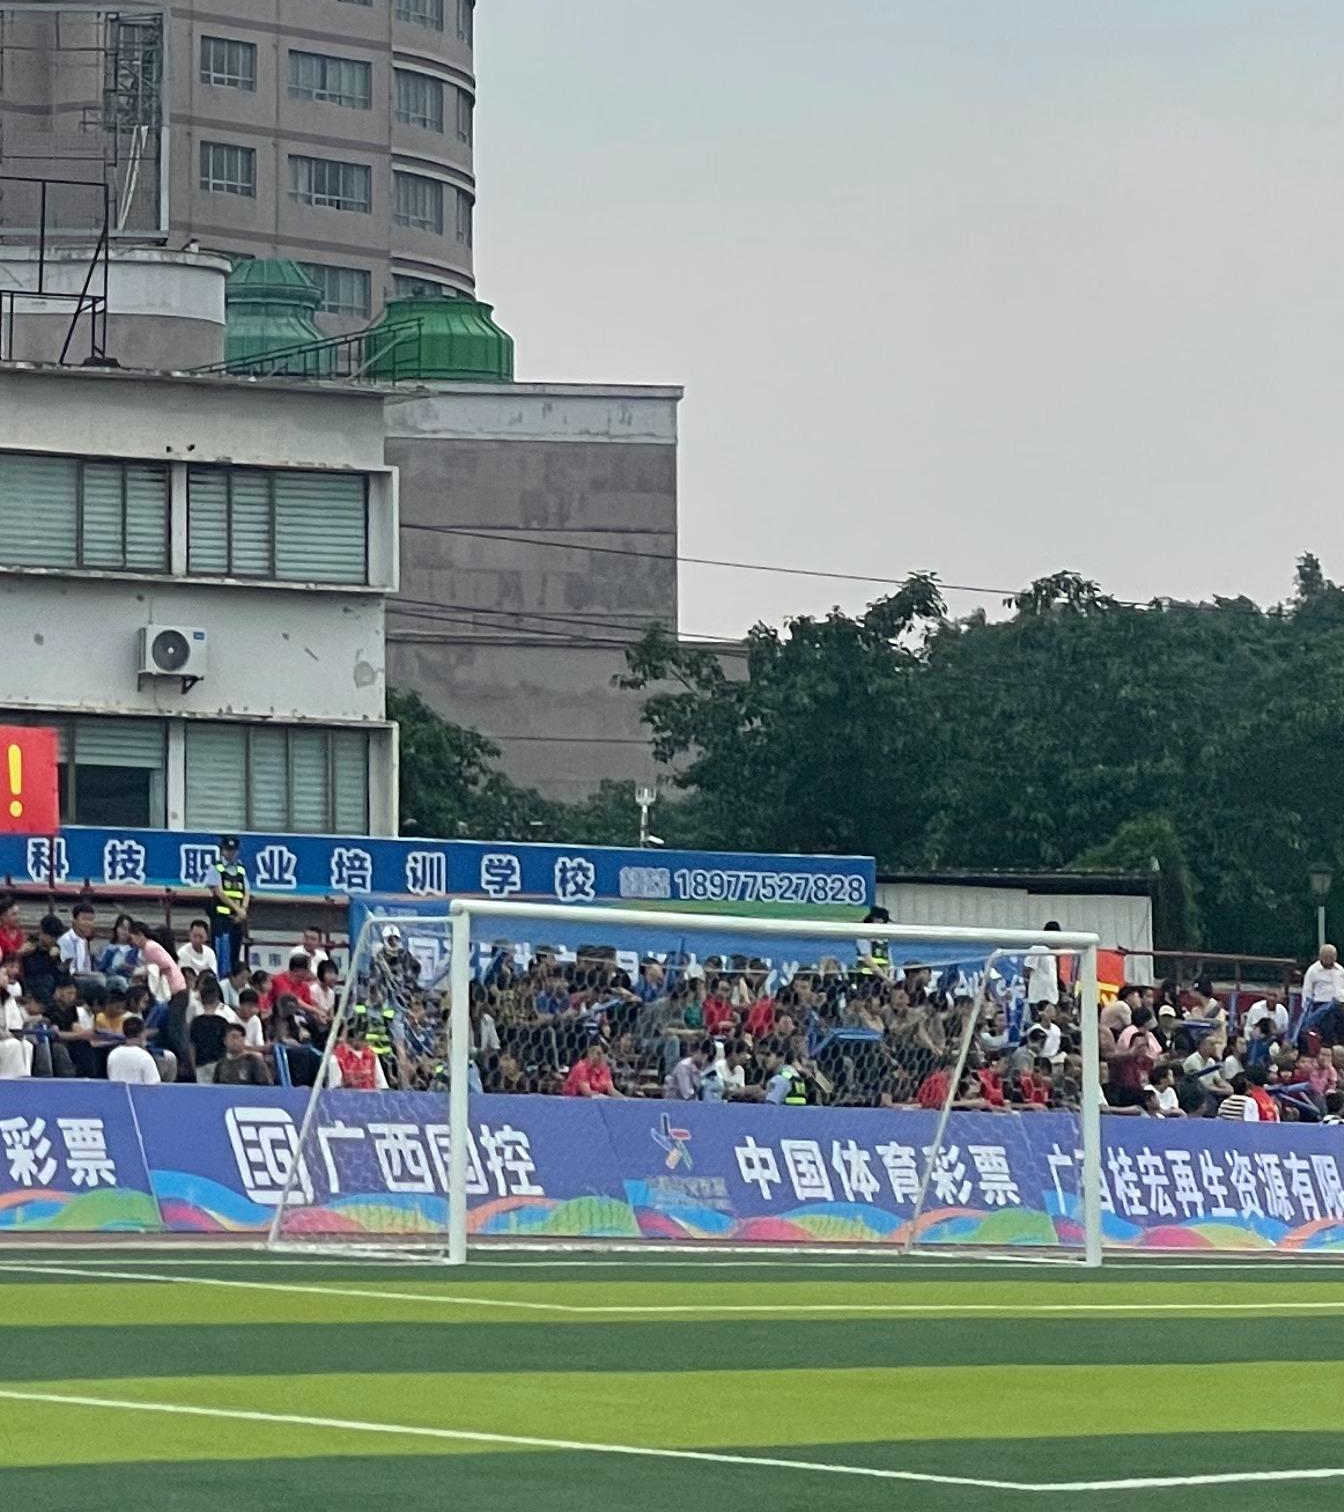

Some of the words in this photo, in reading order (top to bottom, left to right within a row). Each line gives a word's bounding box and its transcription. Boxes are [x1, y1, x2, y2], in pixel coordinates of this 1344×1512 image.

[674, 869, 866, 905] 18977527828
[317, 1120, 545, 1197] 广西国控
[734, 1135, 1021, 1206] 中国体育彩票
